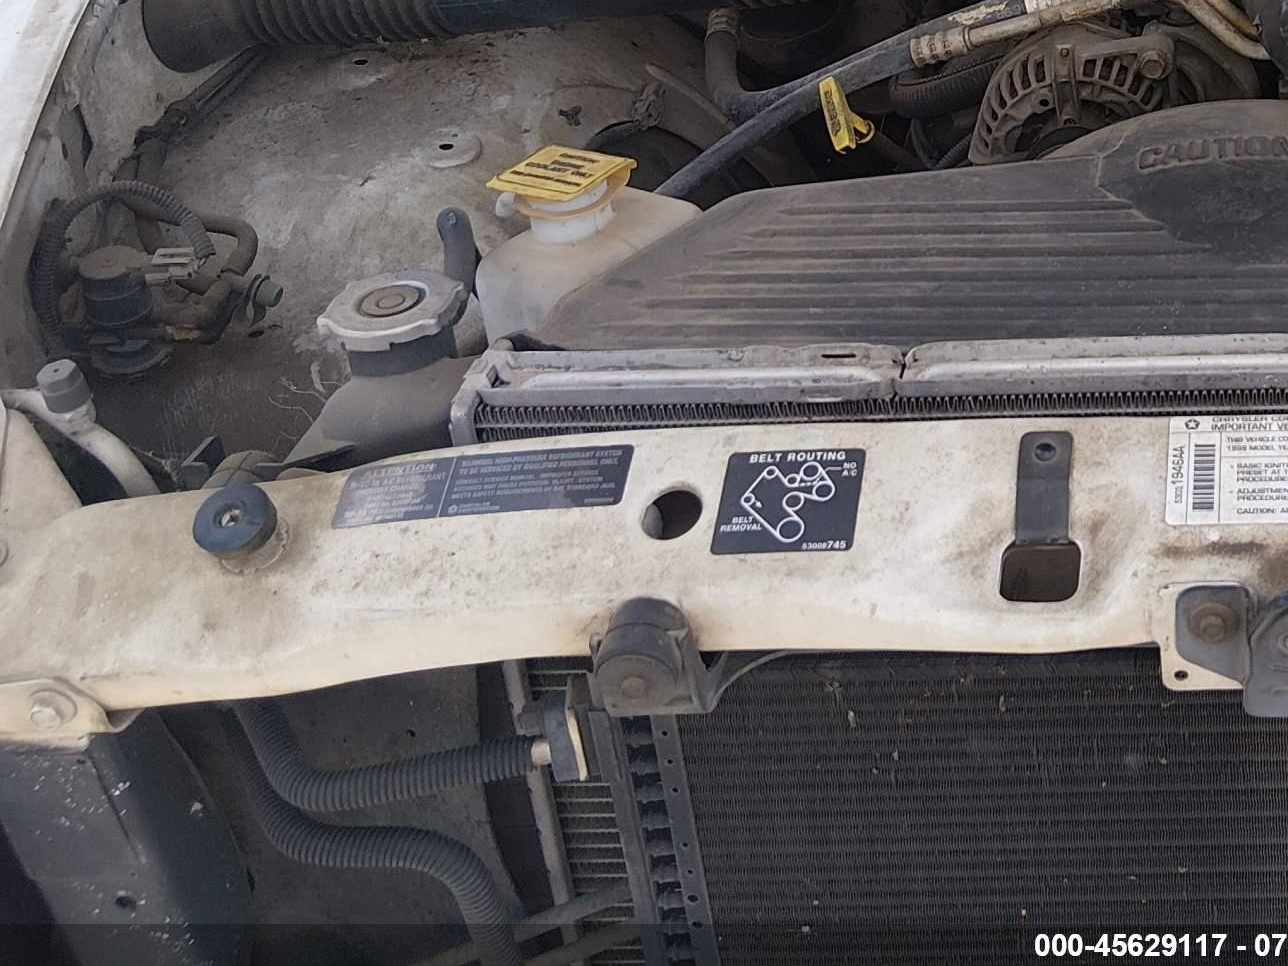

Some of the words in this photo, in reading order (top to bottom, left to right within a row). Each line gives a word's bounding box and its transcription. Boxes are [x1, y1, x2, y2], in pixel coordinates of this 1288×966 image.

[1211, 422, 1274, 431] IMPORTANT
[749, 452, 783, 464] BELT
[787, 450, 847, 462] ROUTING
[843, 461, 857, 469] NO
[731, 516, 754, 524] BELT
[719, 523, 763, 532] REMOVAL
